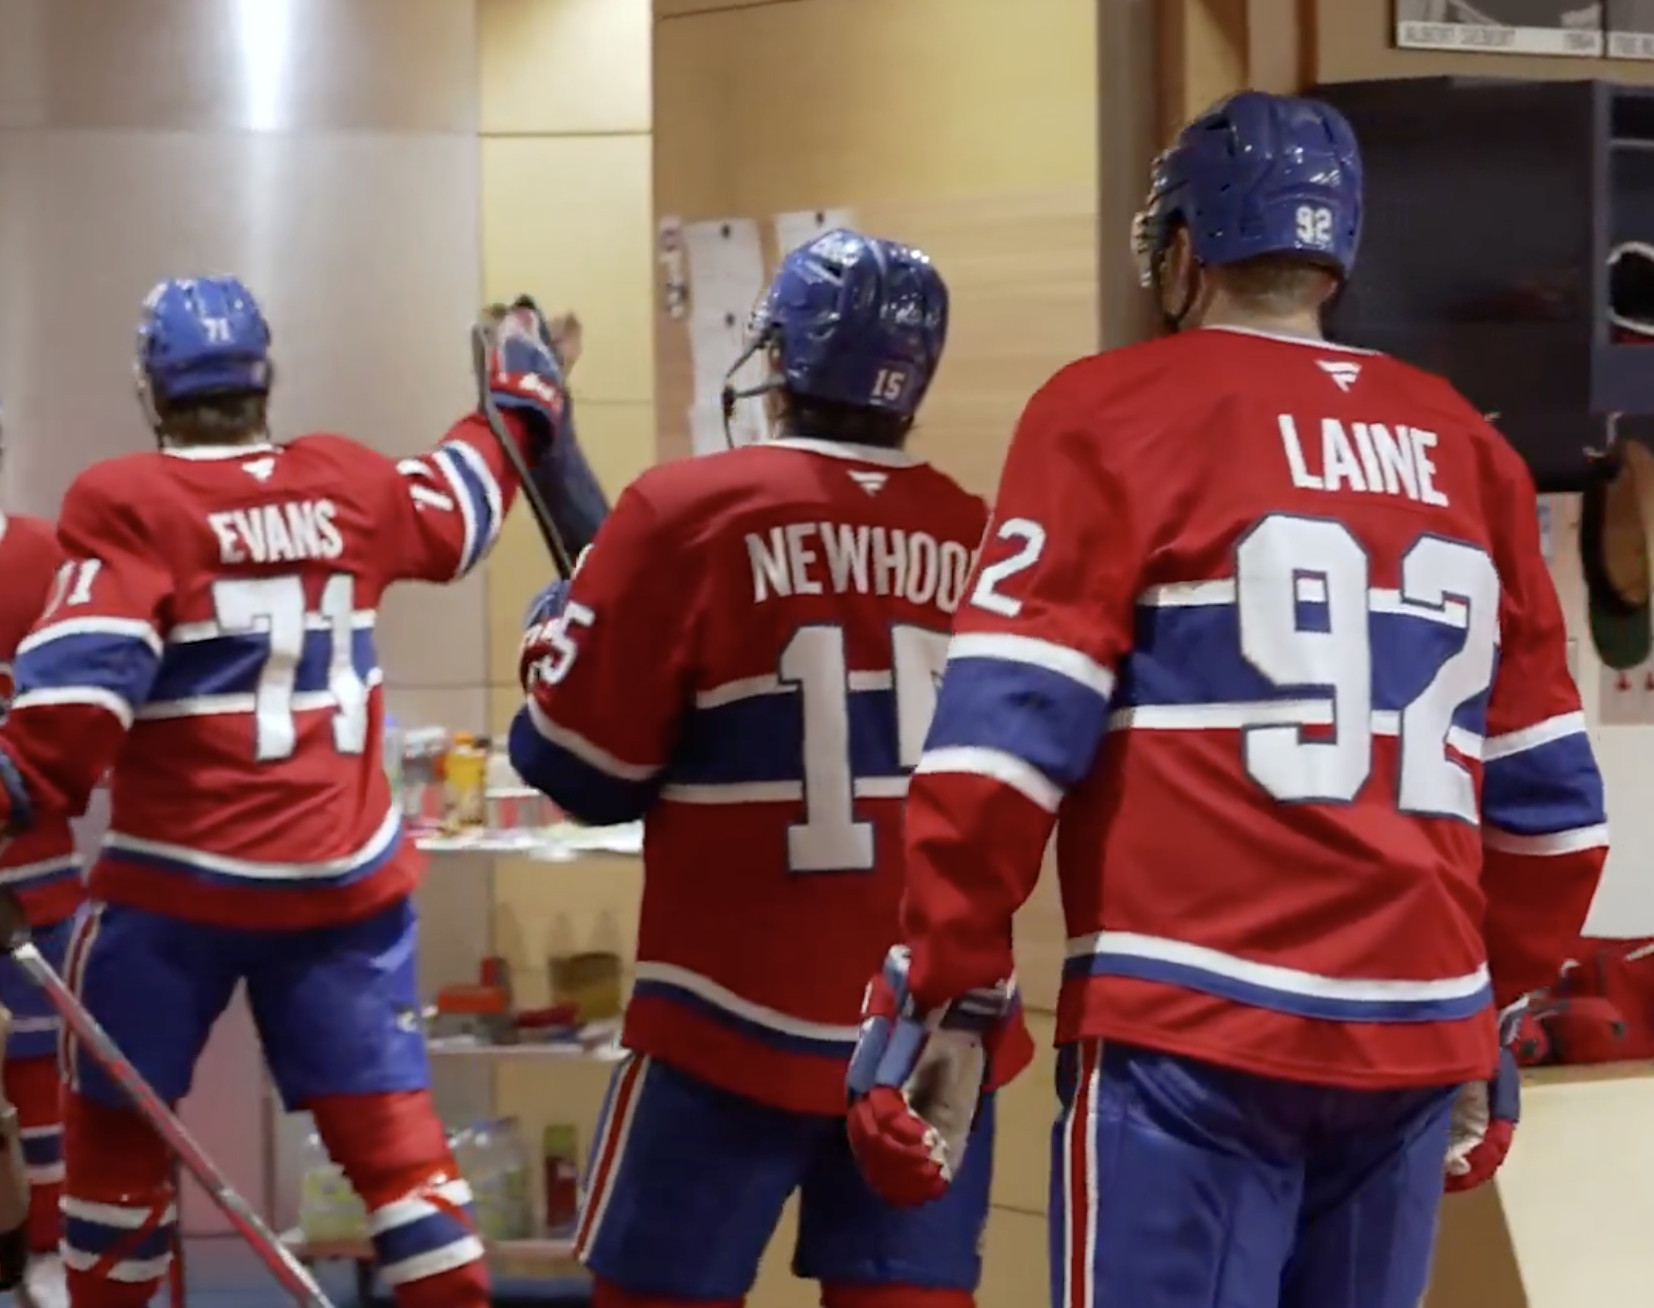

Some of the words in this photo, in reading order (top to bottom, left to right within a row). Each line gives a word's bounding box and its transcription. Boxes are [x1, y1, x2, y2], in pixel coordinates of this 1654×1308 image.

[1296, 205, 1333, 244] 92
[201, 317, 230, 343] 71
[872, 369, 904, 400] 15
[1279, 414, 1448, 506] LAINE
[208, 499, 344, 564] EVANS
[745, 521, 974, 614] NEWHOO
[970, 518, 1046, 618] 2
[211, 574, 370, 763] 71
[536, 601, 596, 686] 5
[1235, 512, 1500, 825] 92
